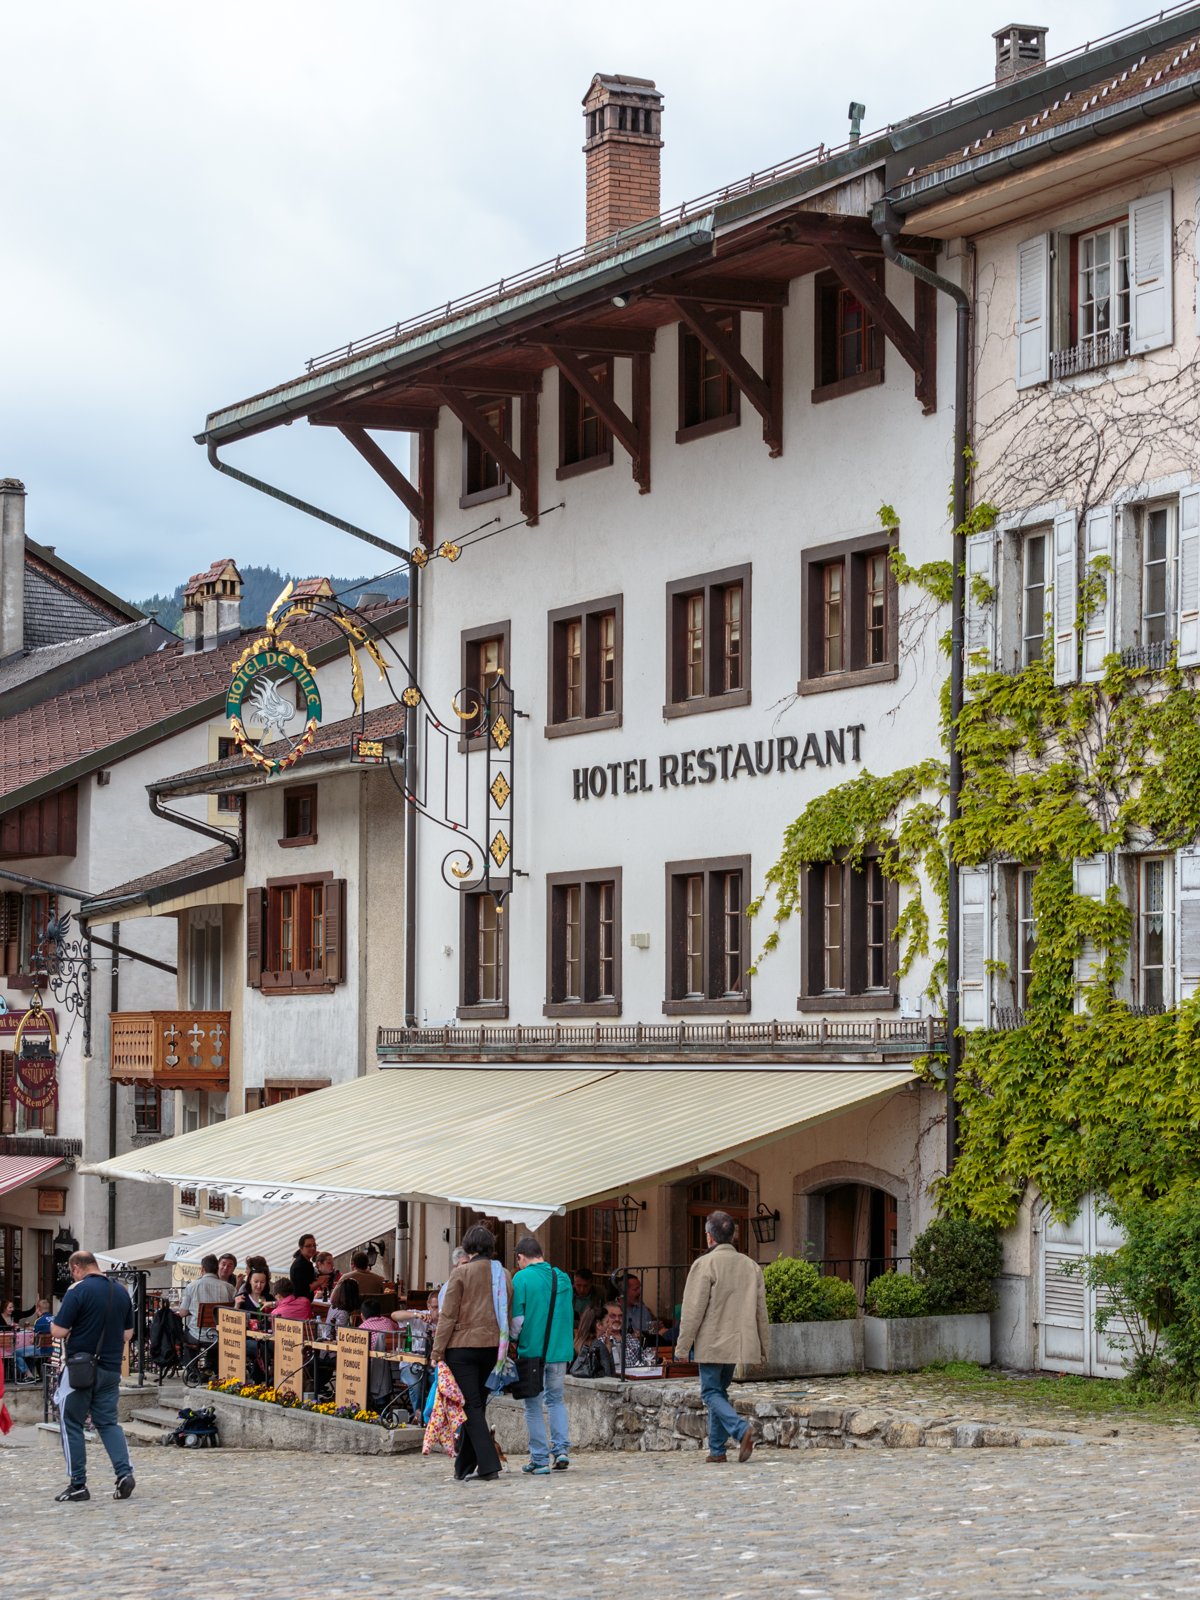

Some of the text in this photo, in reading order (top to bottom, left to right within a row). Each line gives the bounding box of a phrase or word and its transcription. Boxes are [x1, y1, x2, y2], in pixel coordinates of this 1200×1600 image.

[228, 652, 320, 706] HOTEL DE VILLE
[572, 723, 865, 801] HOTEL RESTAURANT
[13, 1085, 57, 1109] des Remparts
[262, 1189, 294, 1201] de
[338, 1332, 345, 1342] Le
[343, 1359, 361, 1370] FONDUE
